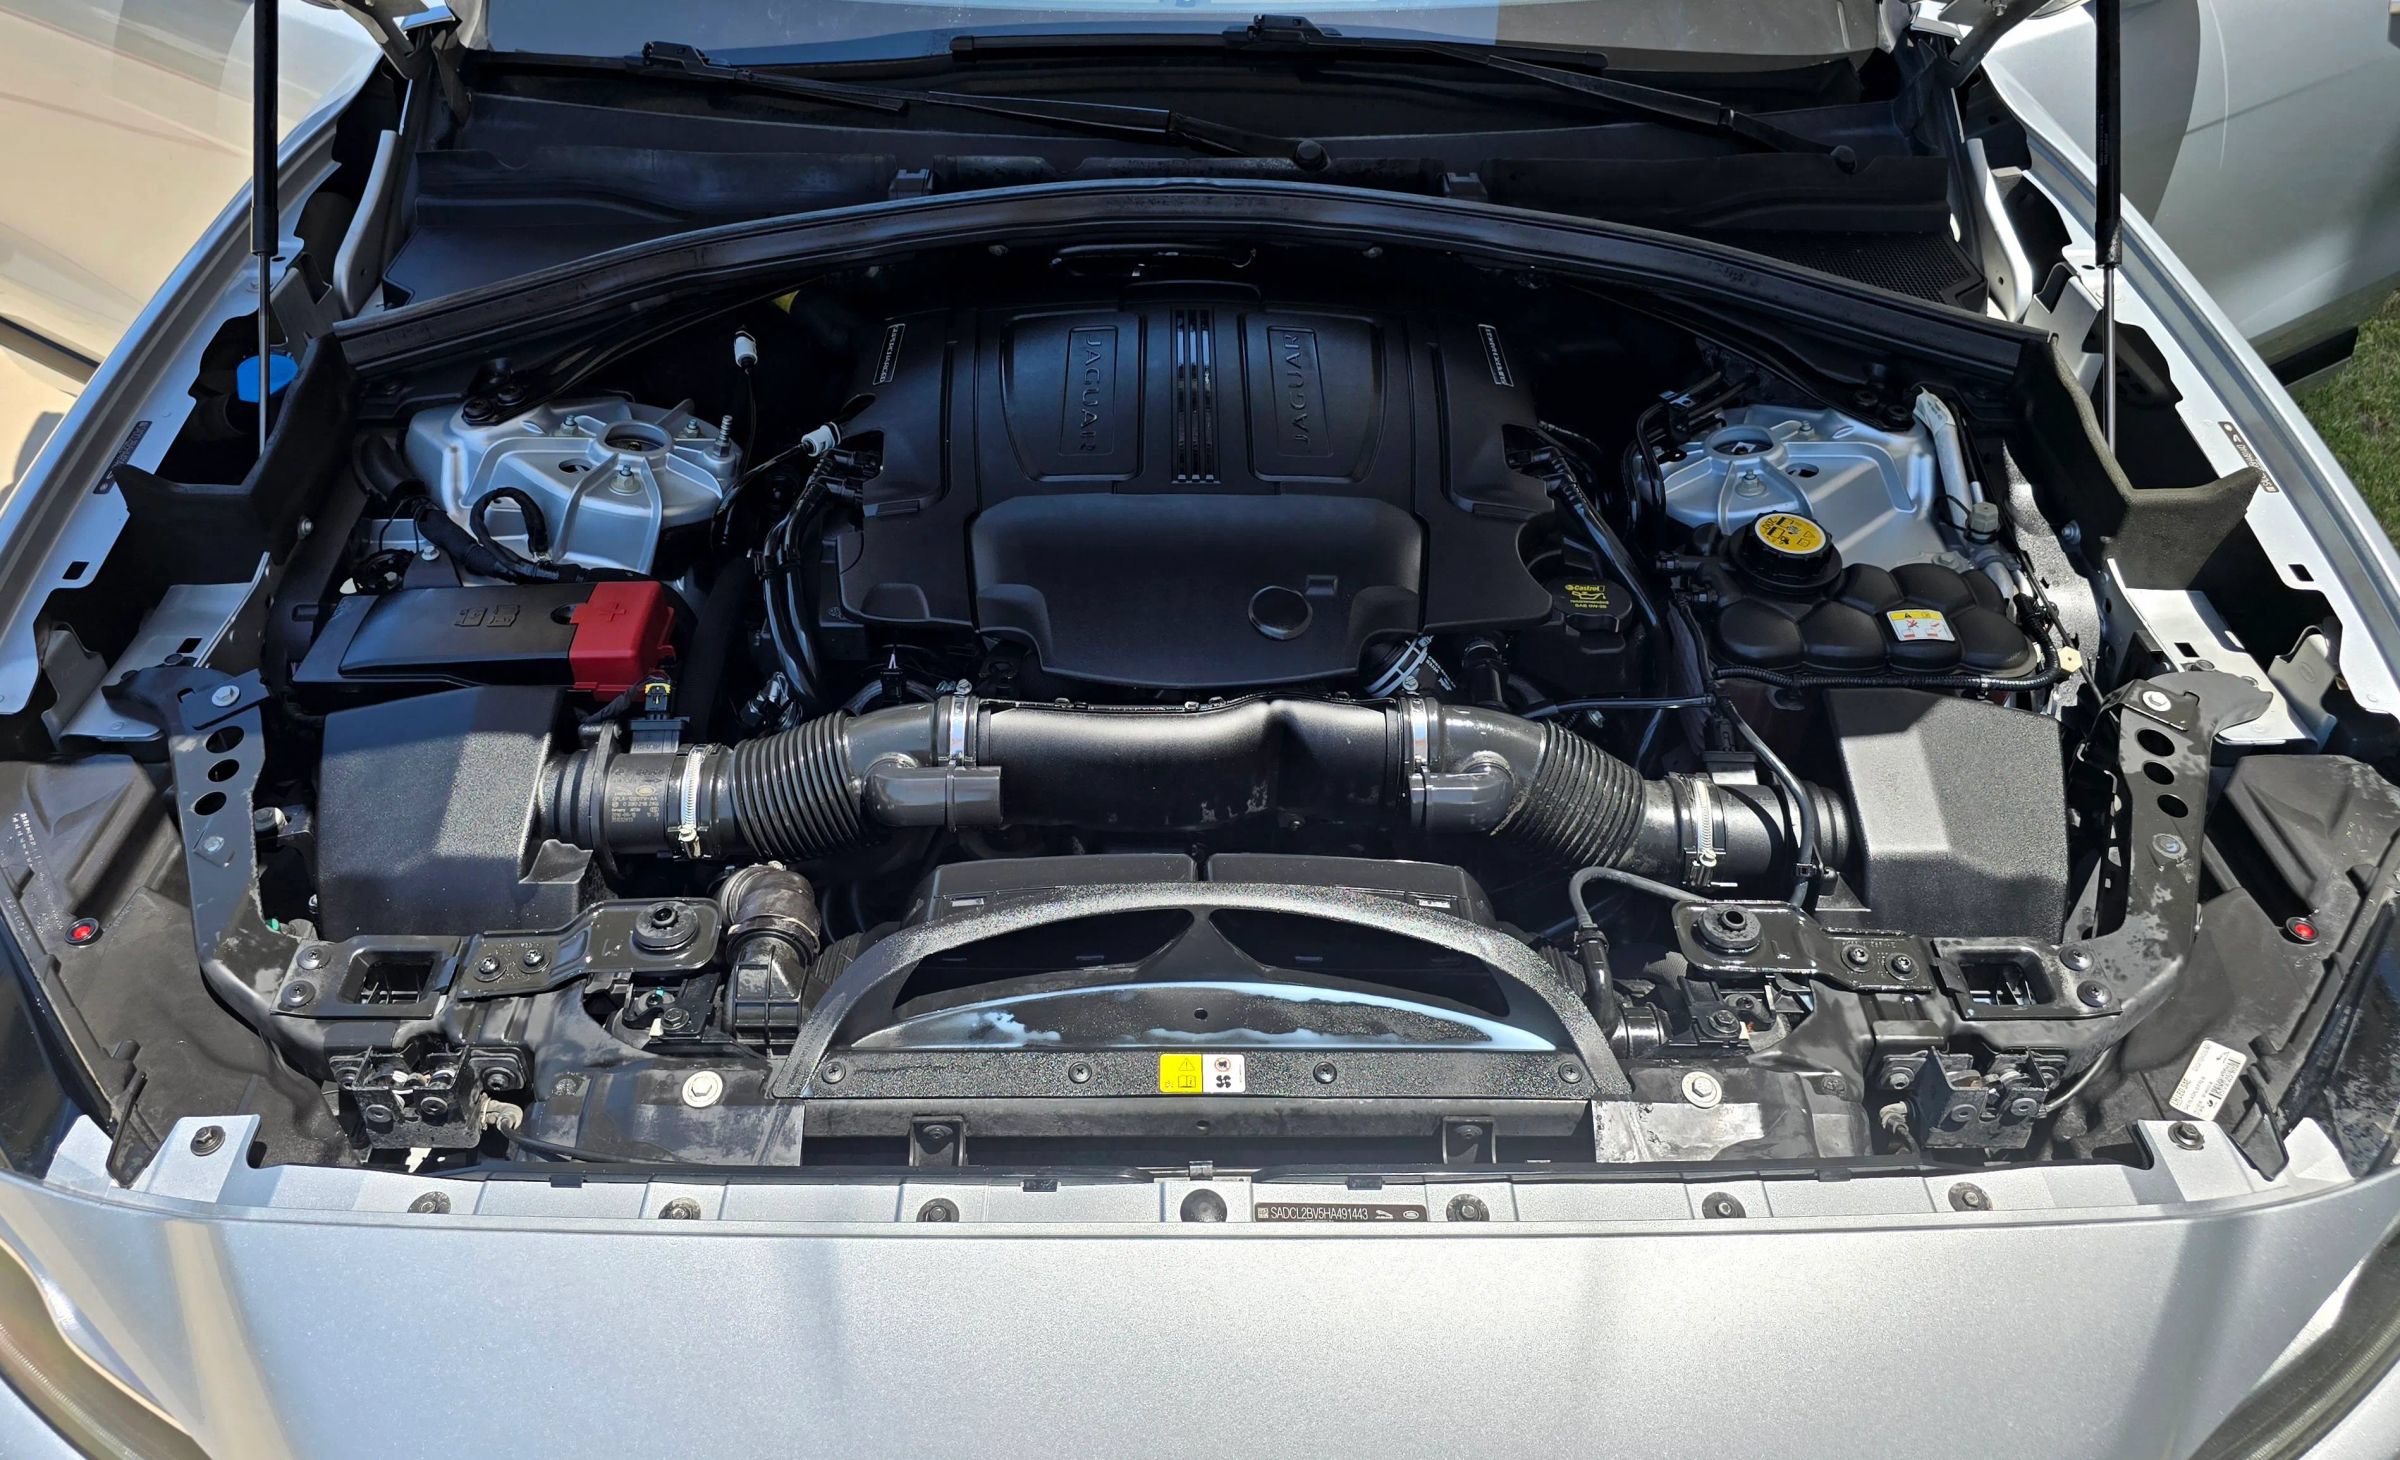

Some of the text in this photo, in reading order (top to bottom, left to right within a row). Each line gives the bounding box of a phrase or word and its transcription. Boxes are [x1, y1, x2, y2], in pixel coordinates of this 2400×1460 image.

[1080, 333, 1101, 451] JAGUAR
[1284, 335, 1311, 446] JAGUAR
[1270, 1206, 1369, 1220] SADCL2BV5HA491443
